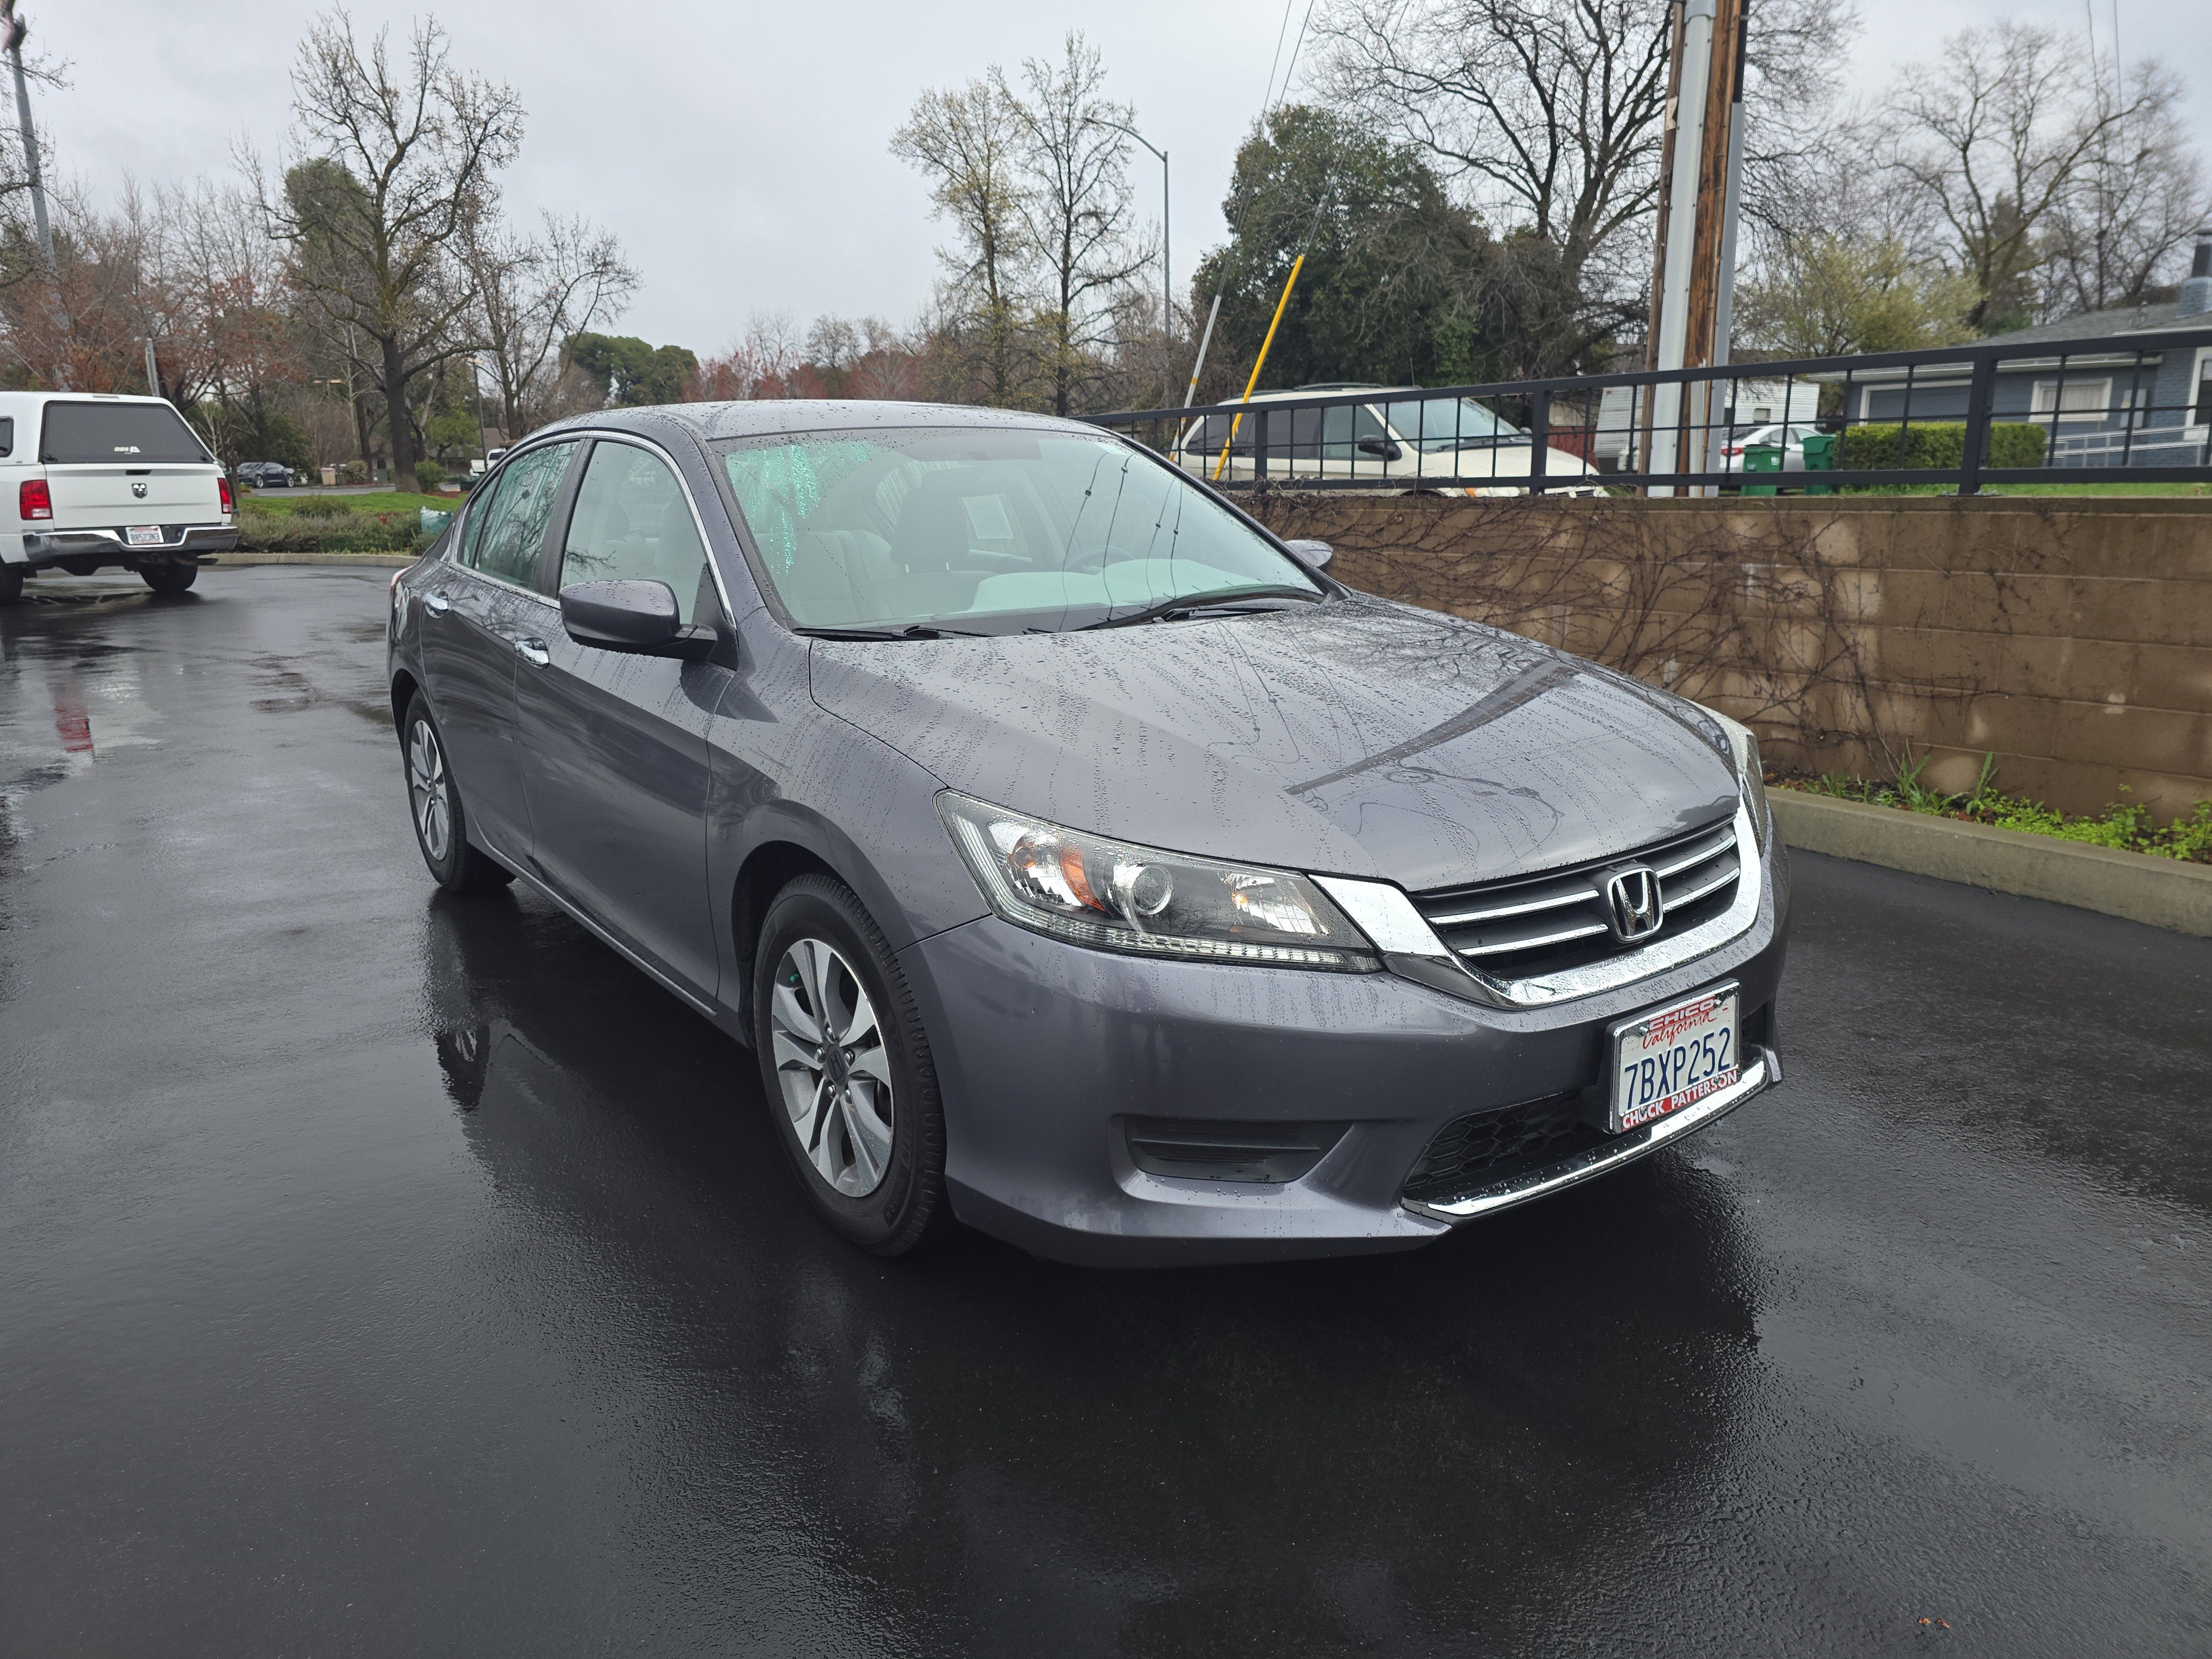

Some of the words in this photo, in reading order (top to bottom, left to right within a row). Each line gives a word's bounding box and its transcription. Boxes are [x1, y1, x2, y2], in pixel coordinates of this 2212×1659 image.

[1643, 1010, 1718, 1050] California
[1649, 999, 1714, 1031] CHICO
[1624, 1027, 1731, 1110] 7BXP252
[1623, 1100, 1666, 1129] CHUCK
[1671, 1070, 1738, 1109] PATTERSON
